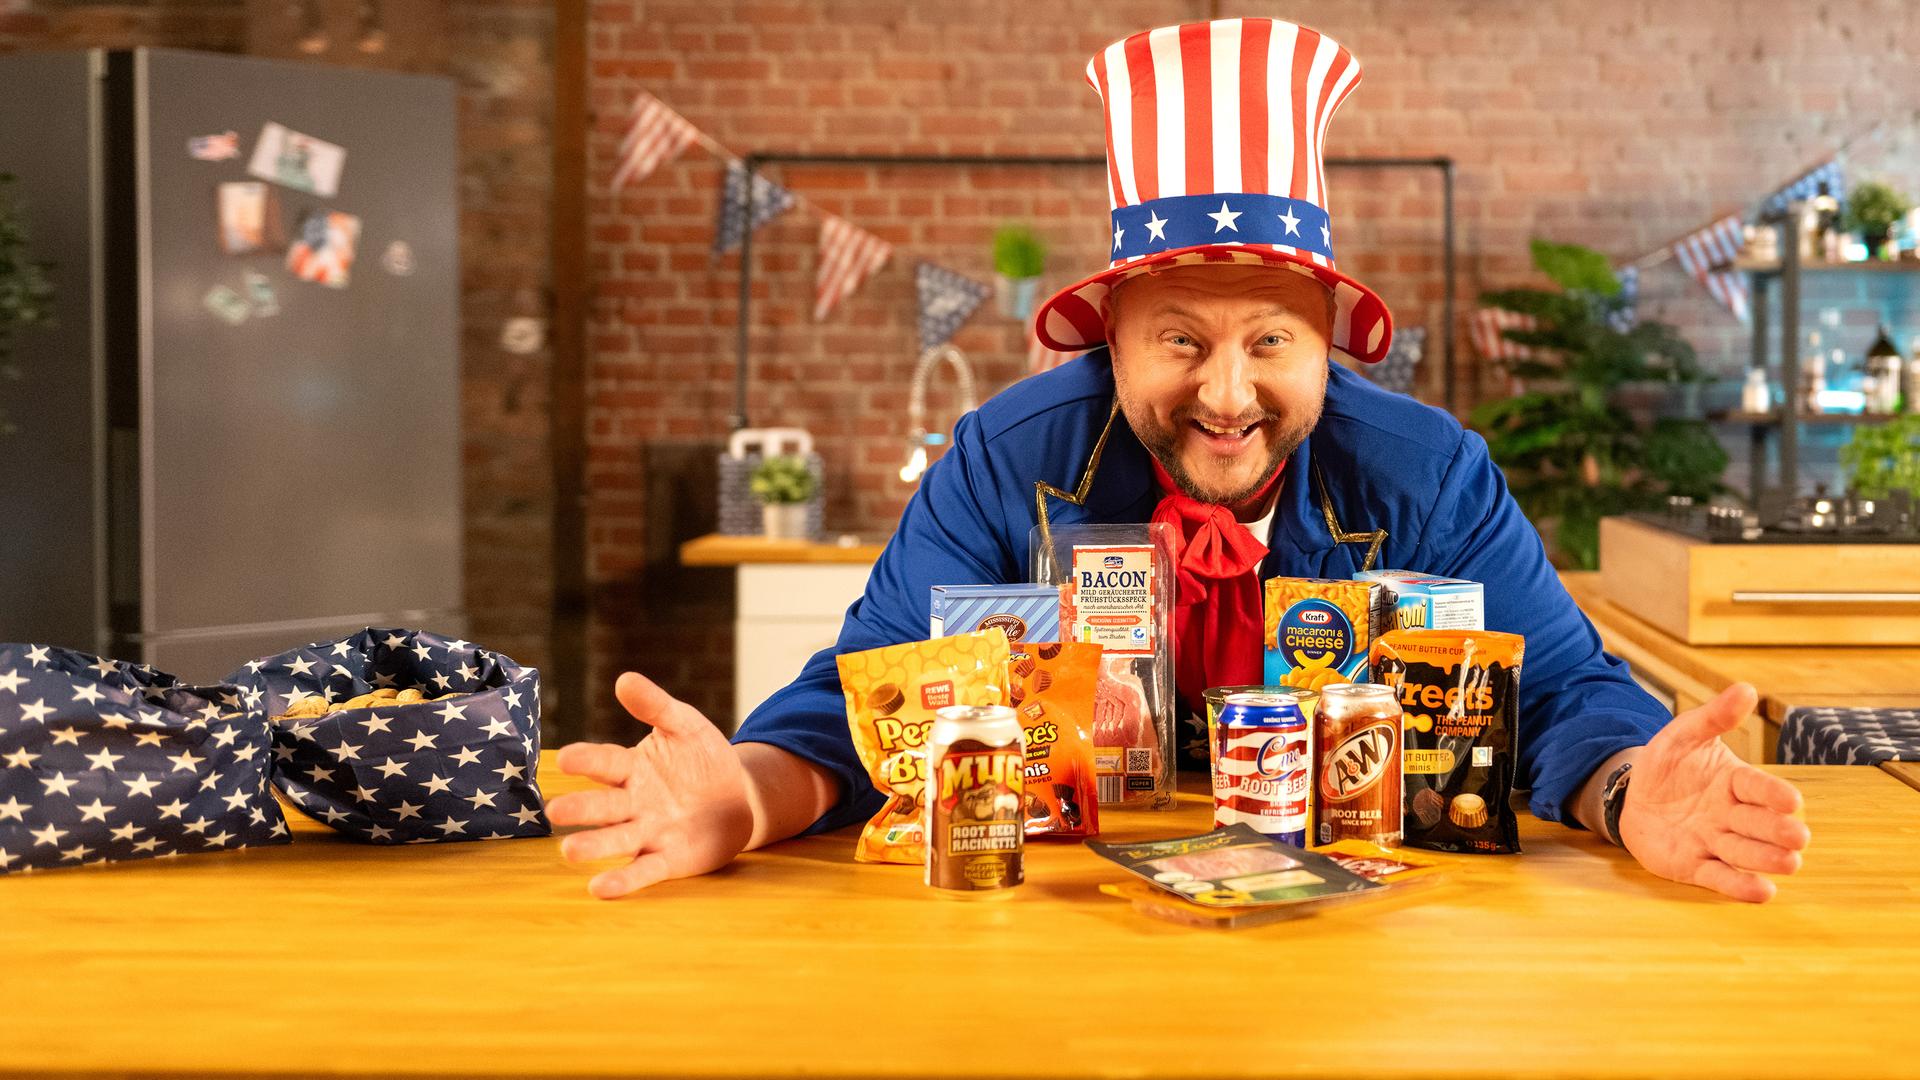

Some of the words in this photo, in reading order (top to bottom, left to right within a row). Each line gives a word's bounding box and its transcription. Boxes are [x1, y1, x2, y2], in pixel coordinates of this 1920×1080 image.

[1081, 571, 1147, 588] BACON
[1305, 613, 1325, 621] Kraft
[1286, 626, 1336, 637] macaroni
[1336, 629, 1344, 638] &
[1389, 643, 1417, 652] PEANUT
[1418, 645, 1448, 655] BUTTER
[1449, 647, 1466, 656] CUP
[925, 684, 950, 694] REWE
[927, 693, 949, 701] Beste
[1435, 714, 1455, 726] THE
[1456, 714, 1494, 727] PEANUT
[1023, 720, 1058, 747] se's
[1434, 726, 1482, 738] COMPANY
[1024, 762, 1050, 777] nis
[1334, 729, 1381, 796] A&W
[941, 754, 1025, 801] MUG
[1215, 774, 1231, 790] EER
[1239, 776, 1281, 796] ROOT
[1286, 772, 1307, 795] BEE
[1331, 809, 1358, 819] ROOT
[1359, 809, 1383, 820] BEER
[952, 825, 987, 840] ROOT
[988, 823, 1017, 838] BEER
[952, 836, 1017, 852] RACINETTE
